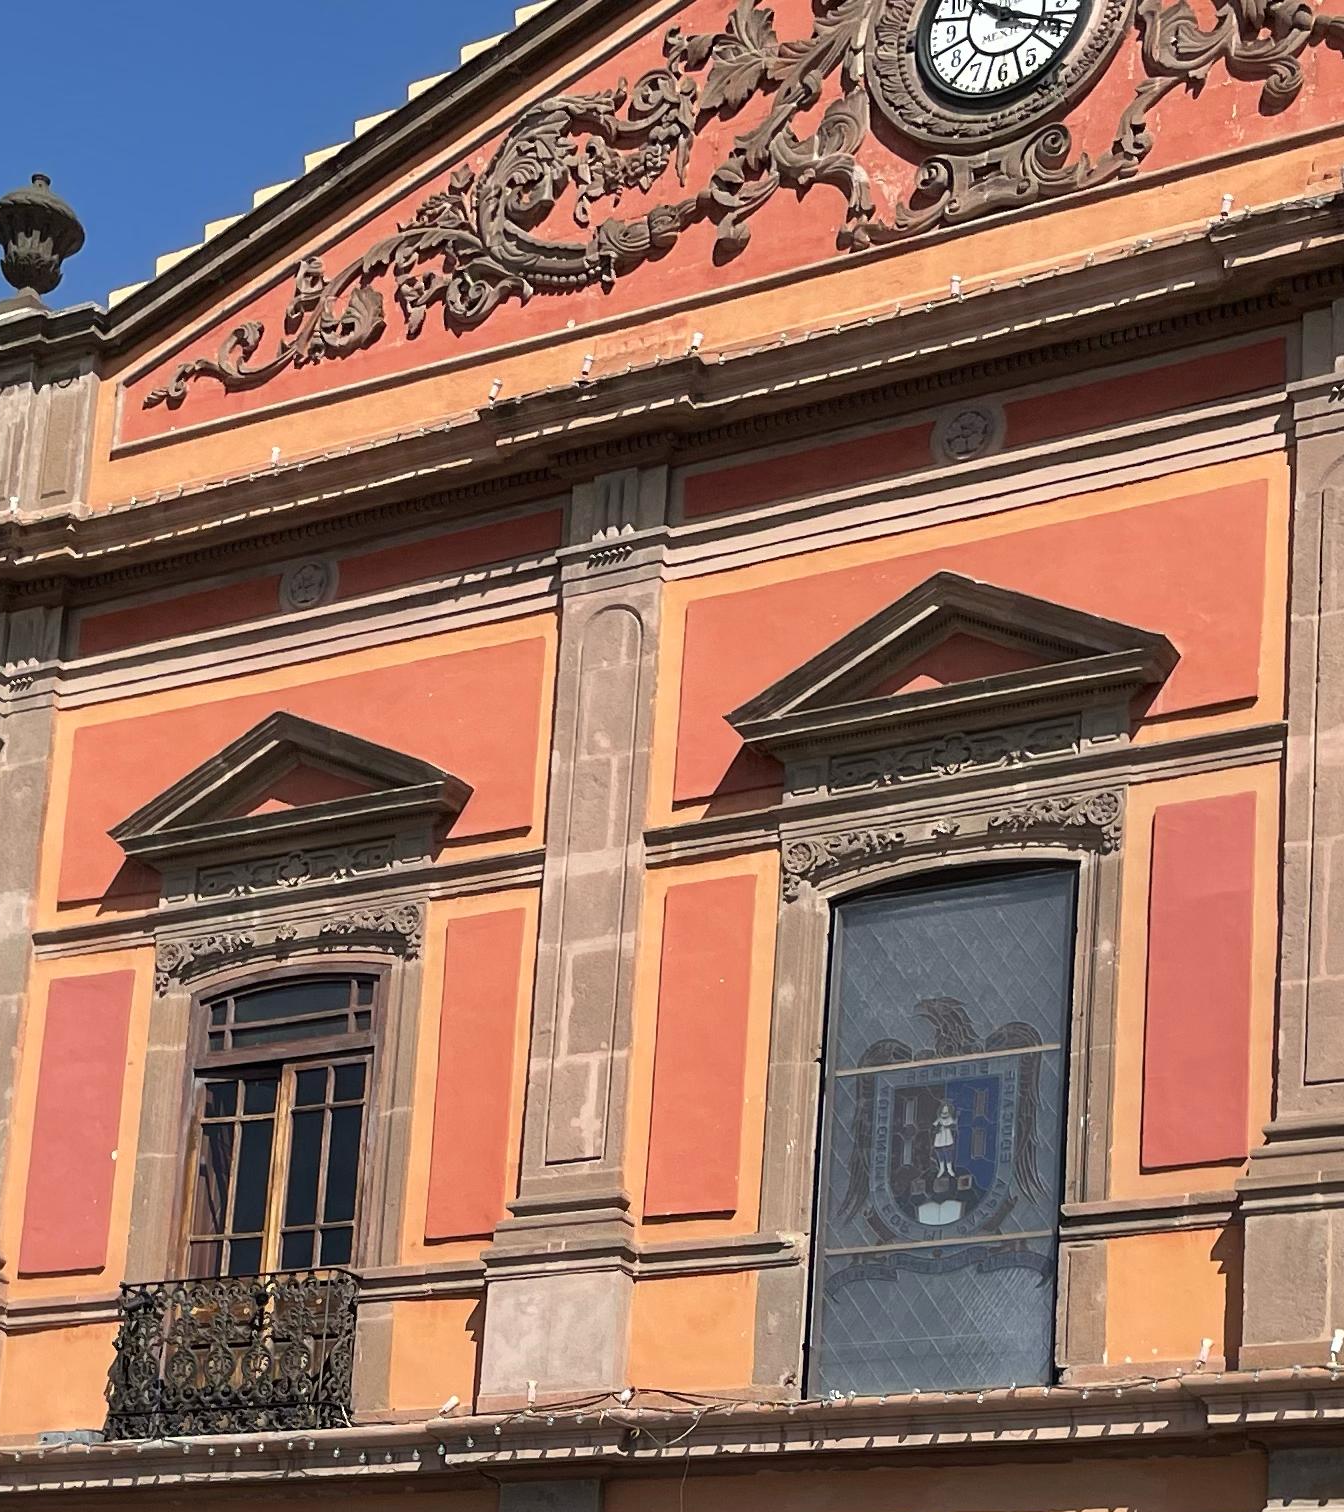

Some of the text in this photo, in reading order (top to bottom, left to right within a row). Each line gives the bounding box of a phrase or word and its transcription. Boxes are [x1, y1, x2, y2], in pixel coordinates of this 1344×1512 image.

[946, 25, 957, 43] 9
[951, 49, 962, 68] 8
[1025, 48, 1037, 67] 5
[970, 62, 982, 83] 7
[998, 62, 1008, 82] 6
